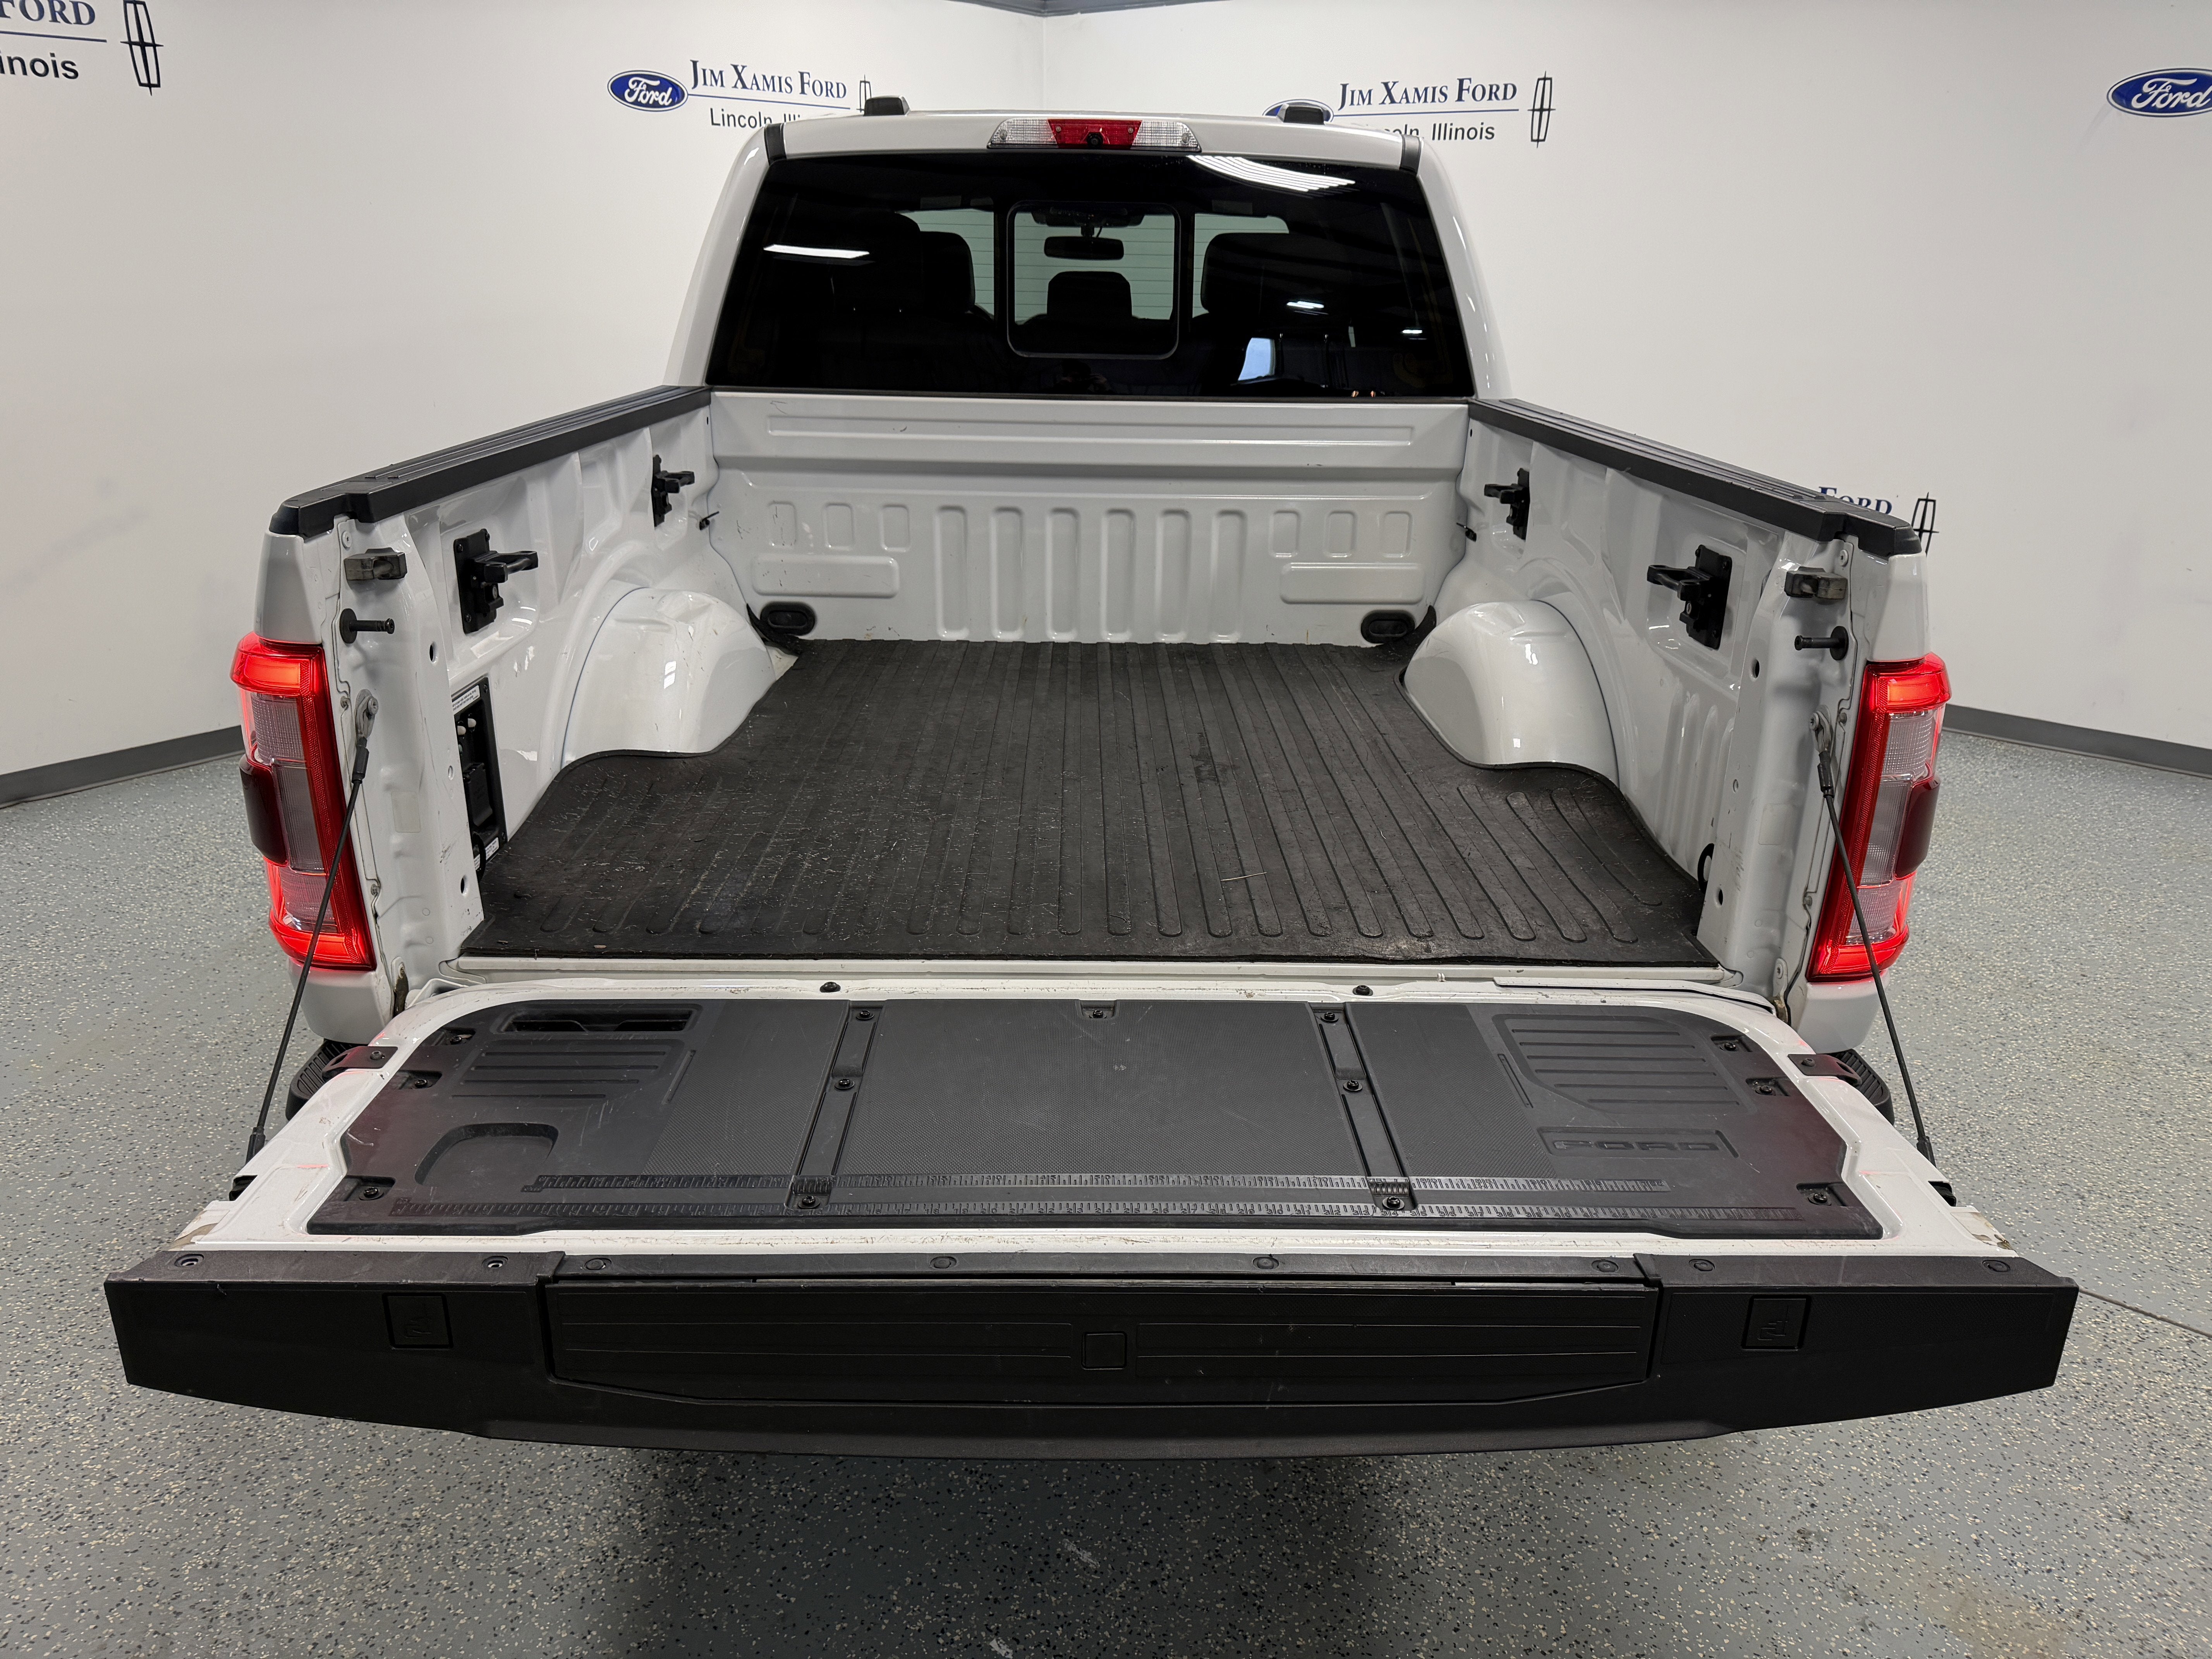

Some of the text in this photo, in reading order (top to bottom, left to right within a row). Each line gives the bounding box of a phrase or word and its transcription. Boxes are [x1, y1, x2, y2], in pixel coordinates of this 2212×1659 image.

[624, 77, 672, 106] Ford
[690, 59, 847, 99] JIM XAMIS FORD
[2131, 78, 2212, 108] Ford
[1338, 77, 1517, 111] JIM XAMIS FORD
[1432, 122, 1495, 141] Illinois
[1553, 1140, 1719, 1151] FORD
